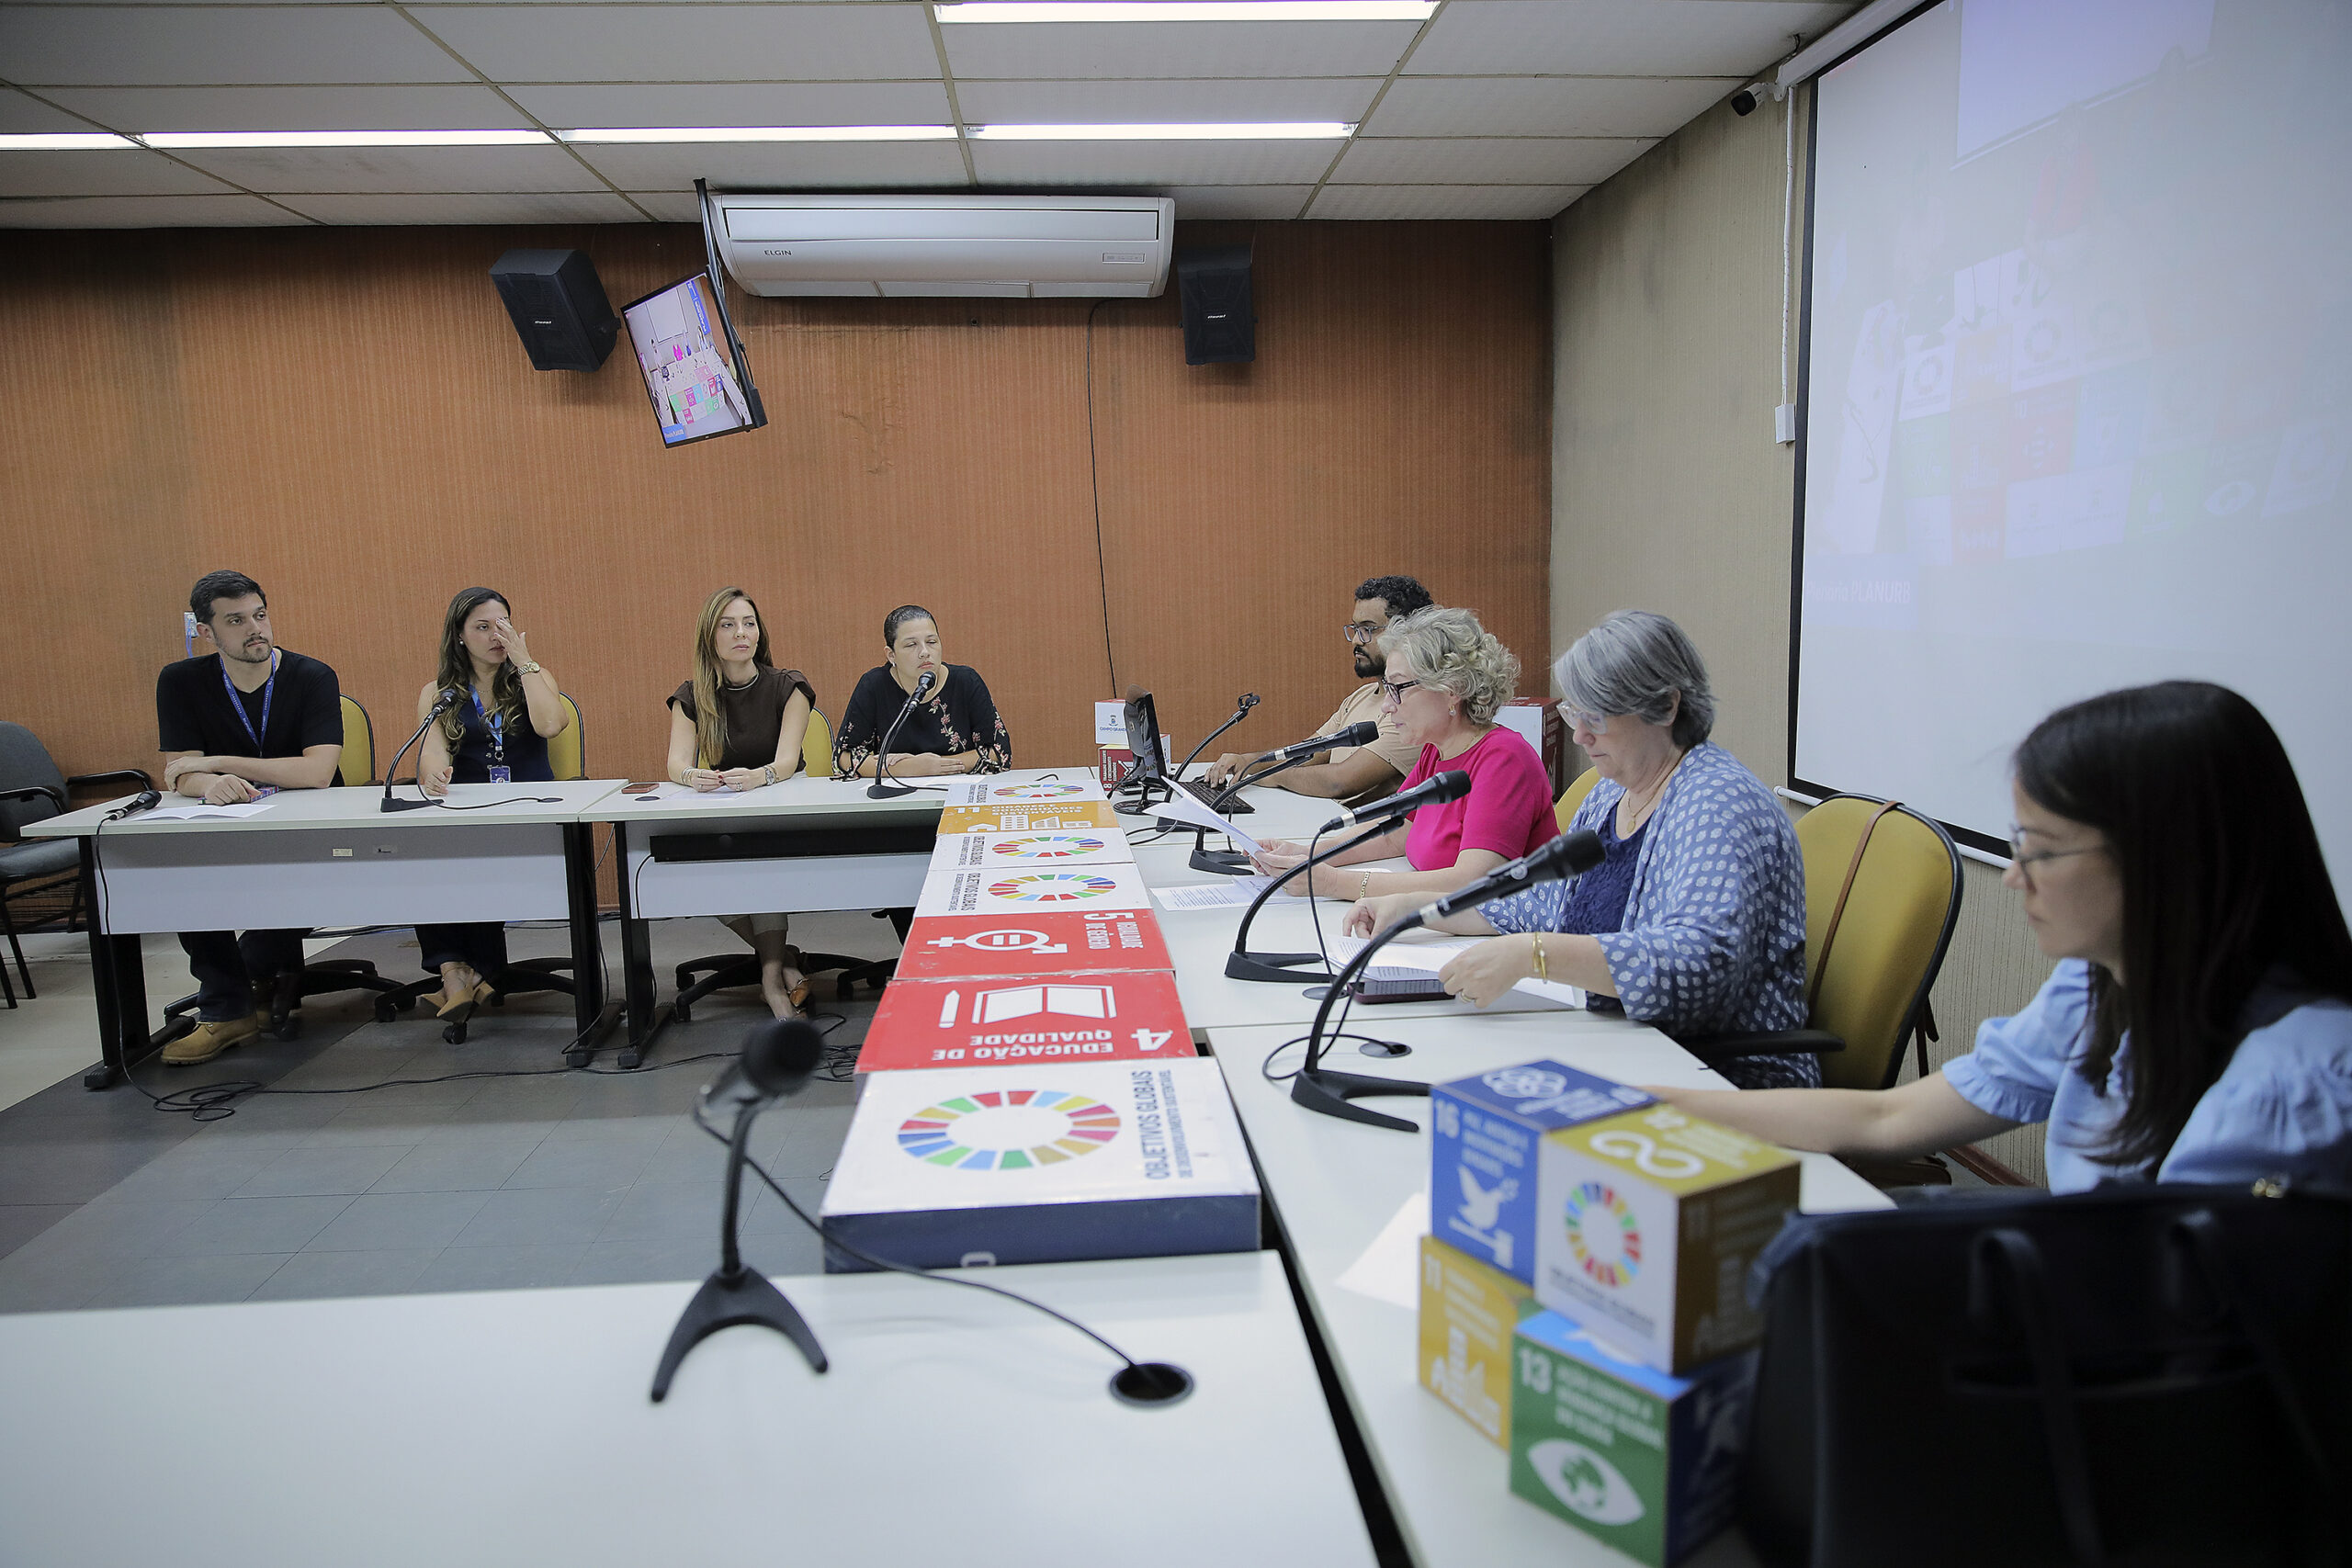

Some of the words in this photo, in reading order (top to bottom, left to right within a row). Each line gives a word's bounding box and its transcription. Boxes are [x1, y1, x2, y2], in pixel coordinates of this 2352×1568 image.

[1851, 581, 1911, 604] PLANURB
[1083, 912, 1136, 920] 5
[1085, 922, 1106, 931] DE
[1086, 930, 1114, 950] GÊNERO
[969, 1029, 1113, 1045] QUALIDADE
[1130, 1028, 1173, 1051] 4
[931, 1048, 966, 1061] DE
[973, 1042, 1114, 1061] EDUCAÇÃO
[1130, 1070, 1159, 1112] GLOBAIS
[1435, 1098, 1460, 1139] 16
[1136, 1113, 1171, 1180] OBJETIVOS
[1425, 1255, 1442, 1293] 11
[1519, 1348, 1552, 1394] 13
